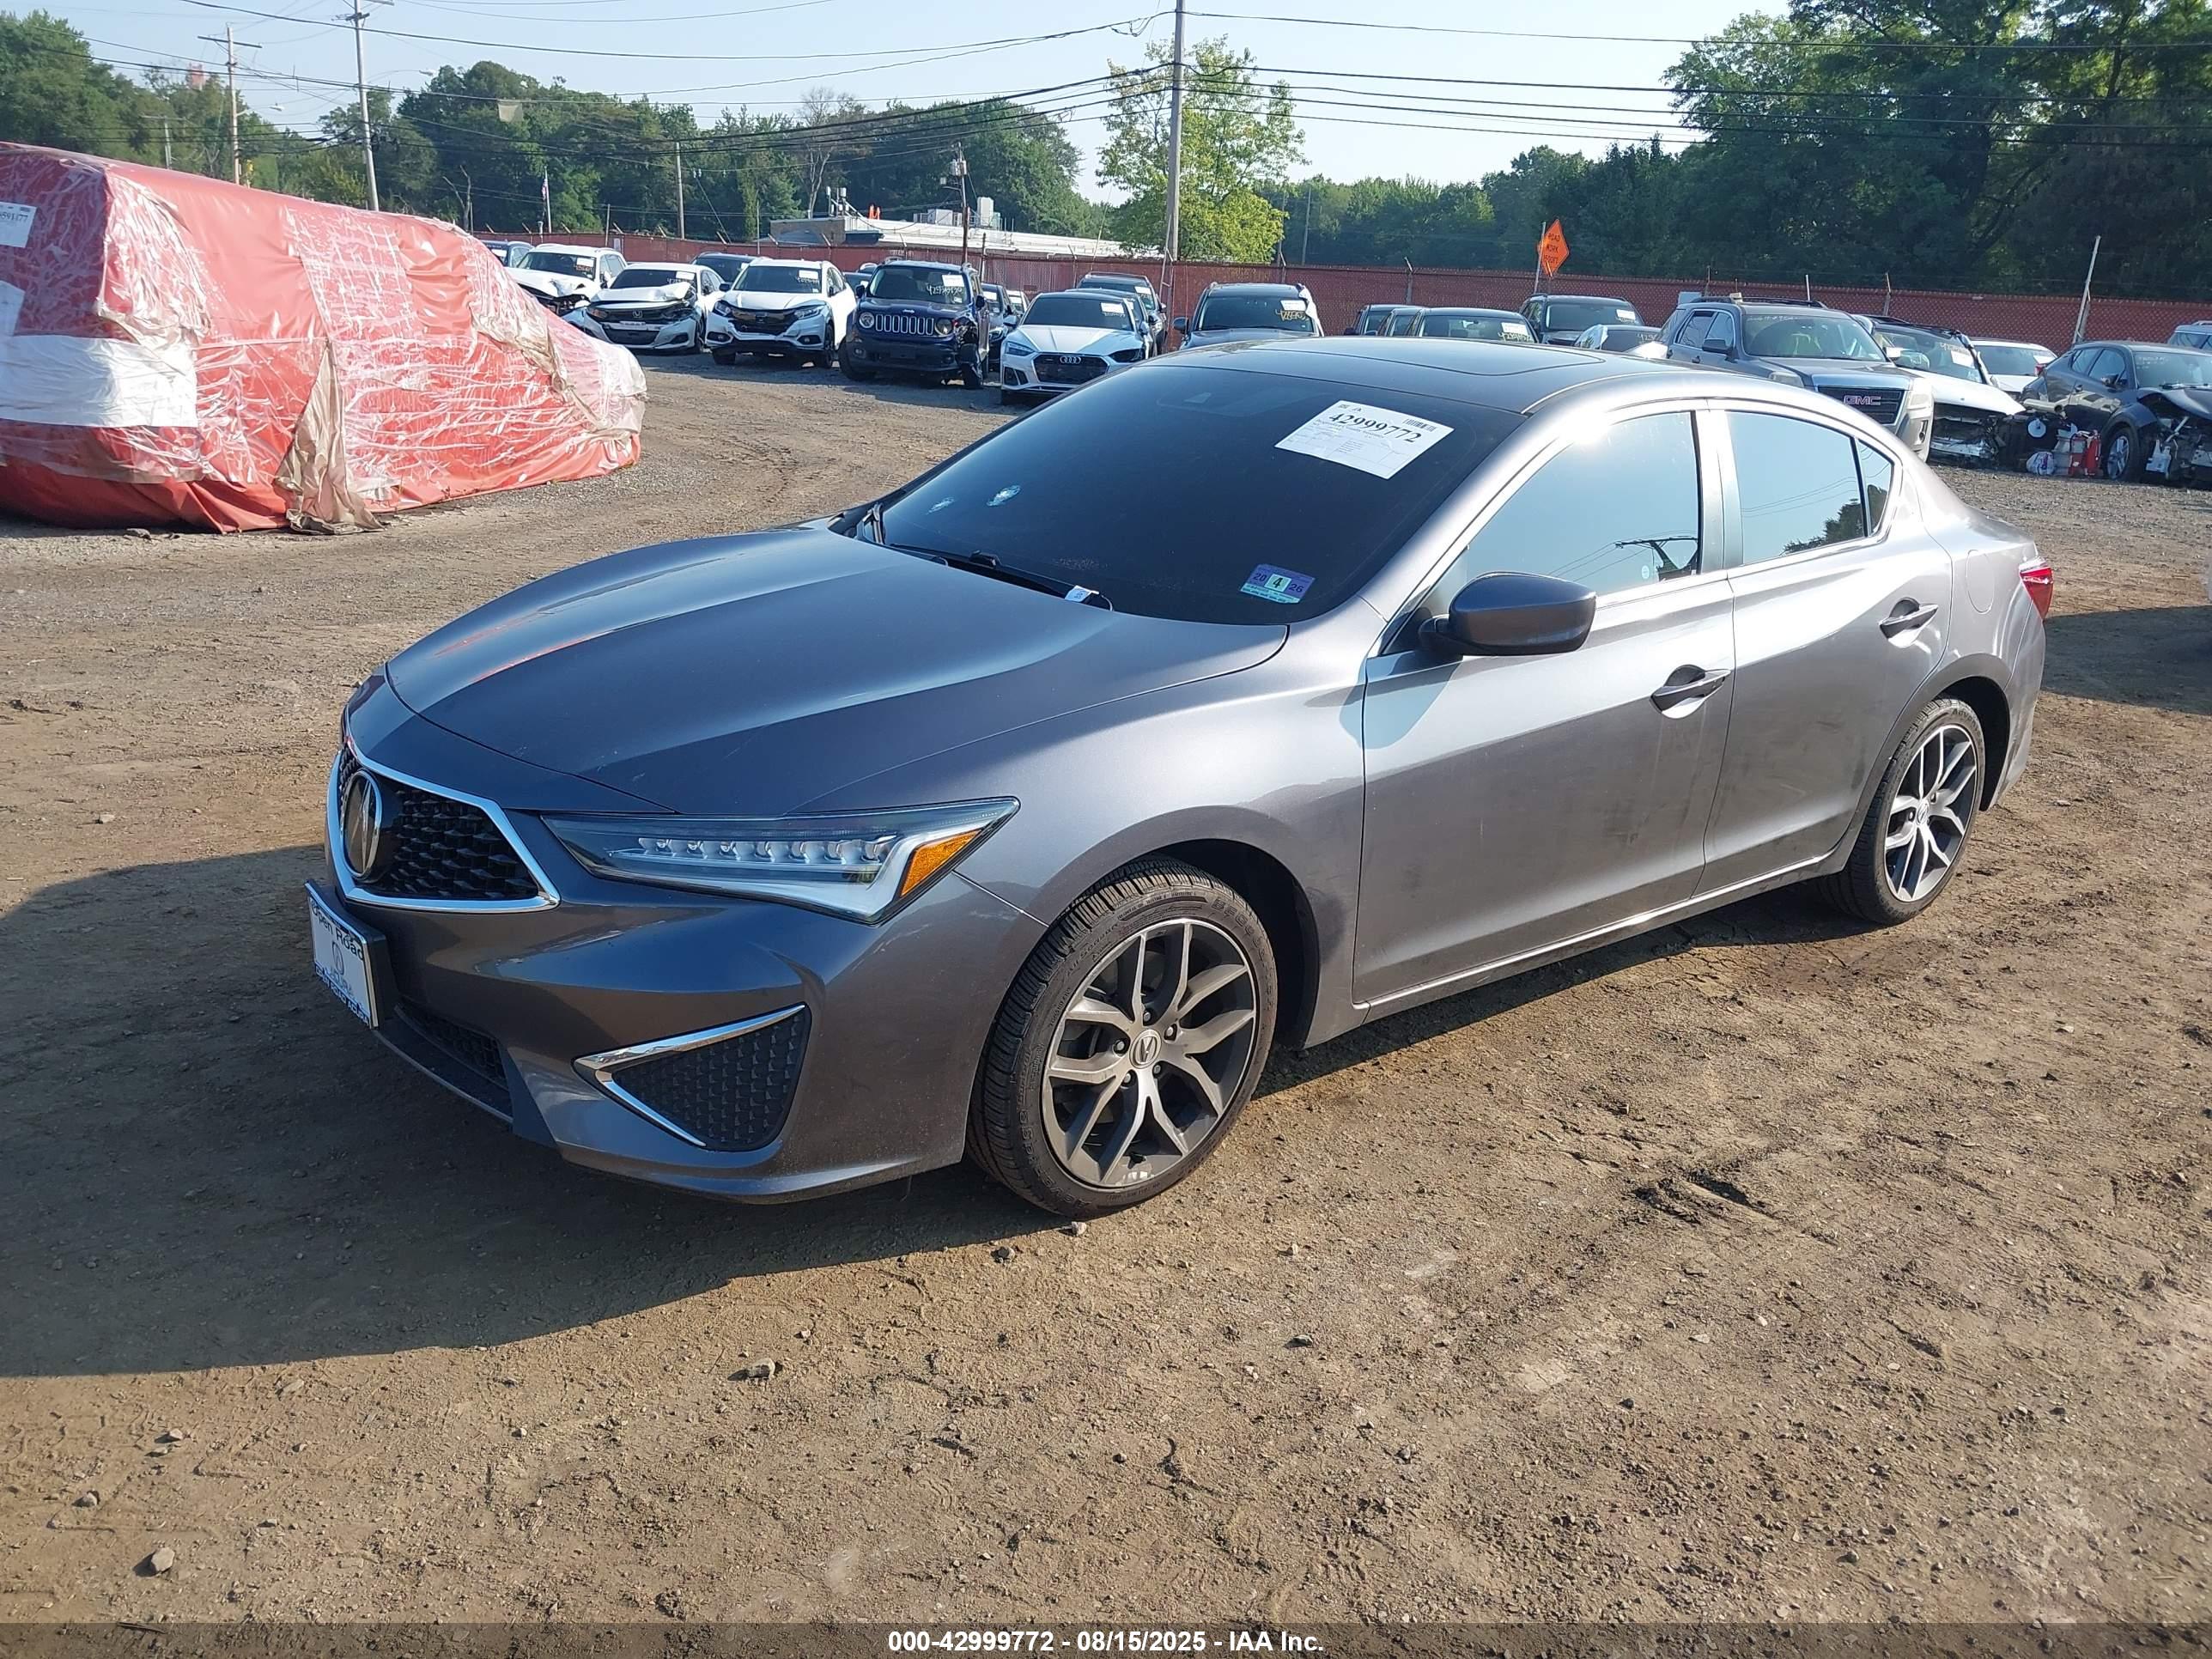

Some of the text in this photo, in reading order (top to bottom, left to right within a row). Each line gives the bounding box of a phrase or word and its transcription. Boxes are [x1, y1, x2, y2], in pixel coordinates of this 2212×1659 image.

[1844, 395, 1881, 405] GMC
[1253, 573, 1304, 592] 20 4 26
[312, 899, 333, 935] Open
[1328, 1272, 1422, 1302] 42999772
